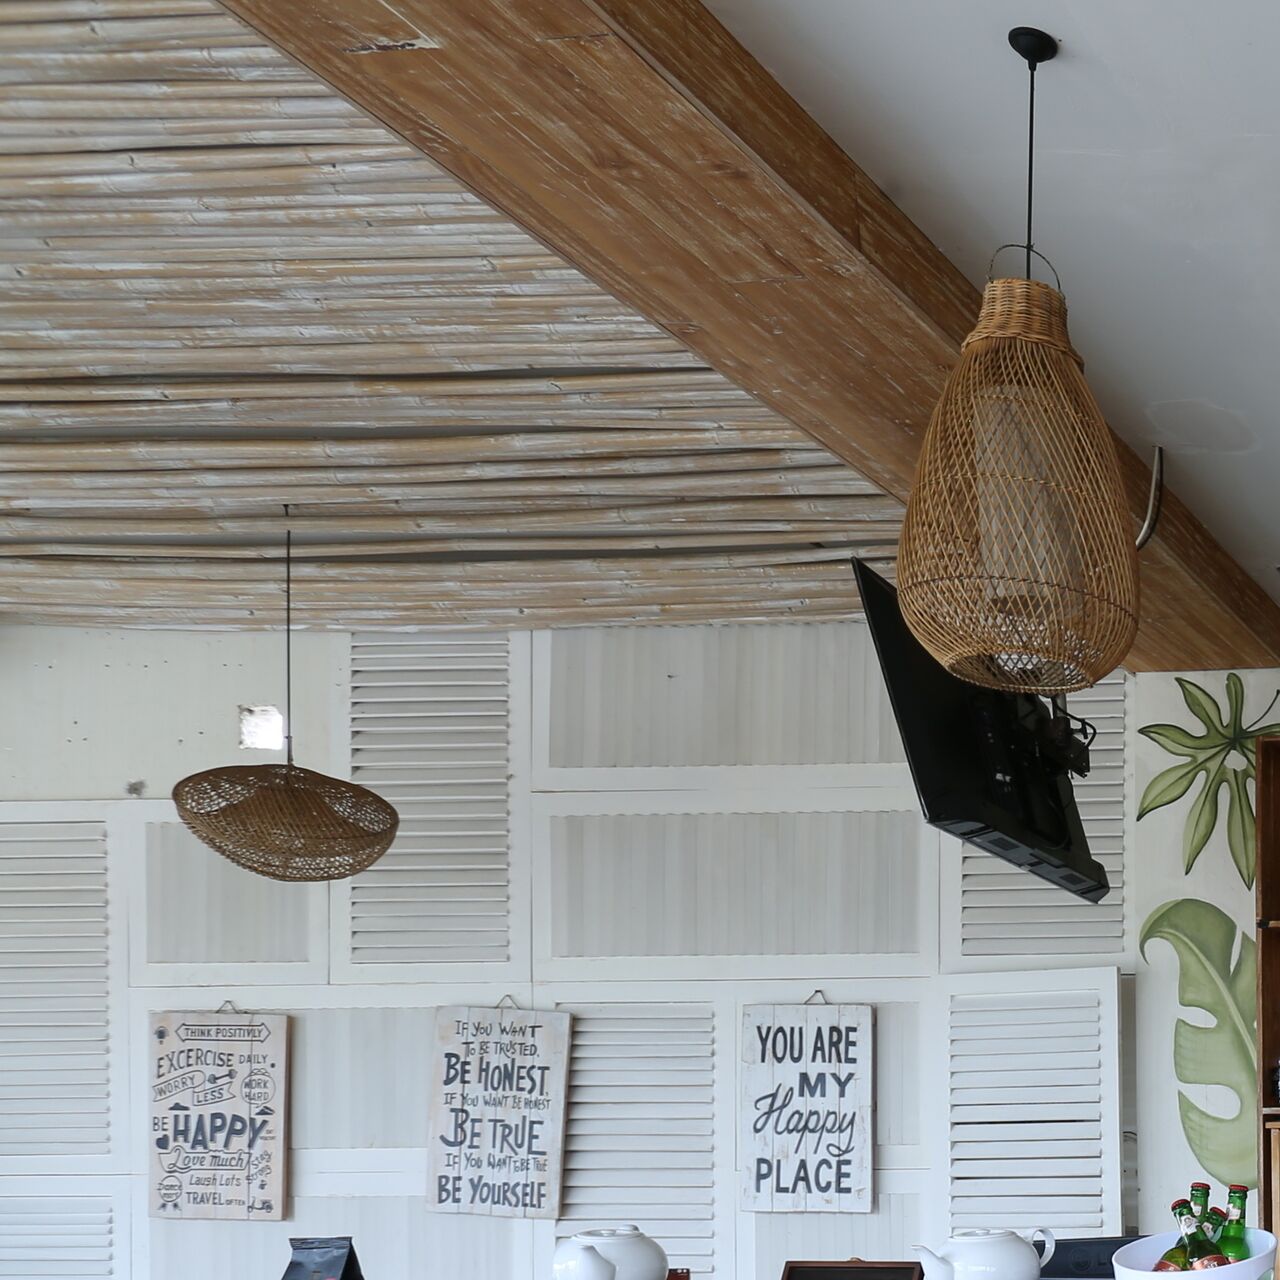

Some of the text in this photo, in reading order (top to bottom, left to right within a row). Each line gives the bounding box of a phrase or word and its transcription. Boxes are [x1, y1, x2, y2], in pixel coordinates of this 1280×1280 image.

[184, 1028, 213, 1037] THINK
[455, 1020, 468, 1036] IF
[498, 1021, 543, 1038] WANT
[479, 1041, 490, 1055] BE
[756, 1026, 857, 1064] YOU ARE
[156, 1048, 268, 1079] EXCERCISE DAILY
[443, 1052, 471, 1086] BE
[157, 1075, 224, 1103] WORRY LESS
[244, 1078, 268, 1089] WORK
[245, 1091, 269, 1100] HARD
[798, 1072, 855, 1098] MY
[444, 1092, 551, 1110] IF YOU WANT BE HONEST
[153, 1116, 169, 1131] BE
[173, 1112, 269, 1149] HAPPY
[439, 1107, 547, 1156] BE TRUE
[753, 1083, 856, 1157] Happy
[167, 1147, 206, 1170] Love
[445, 1152, 459, 1170] IF
[464, 1152, 483, 1170] YOU
[487, 1152, 514, 1173] WANT
[520, 1158, 530, 1172] BE
[532, 1157, 548, 1172] TRUE
[189, 1173, 241, 1187] Laugh Lots
[755, 1158, 853, 1194] PLACE
[186, 1192, 224, 1205] TRAVEL
[438, 1175, 462, 1204] BE
